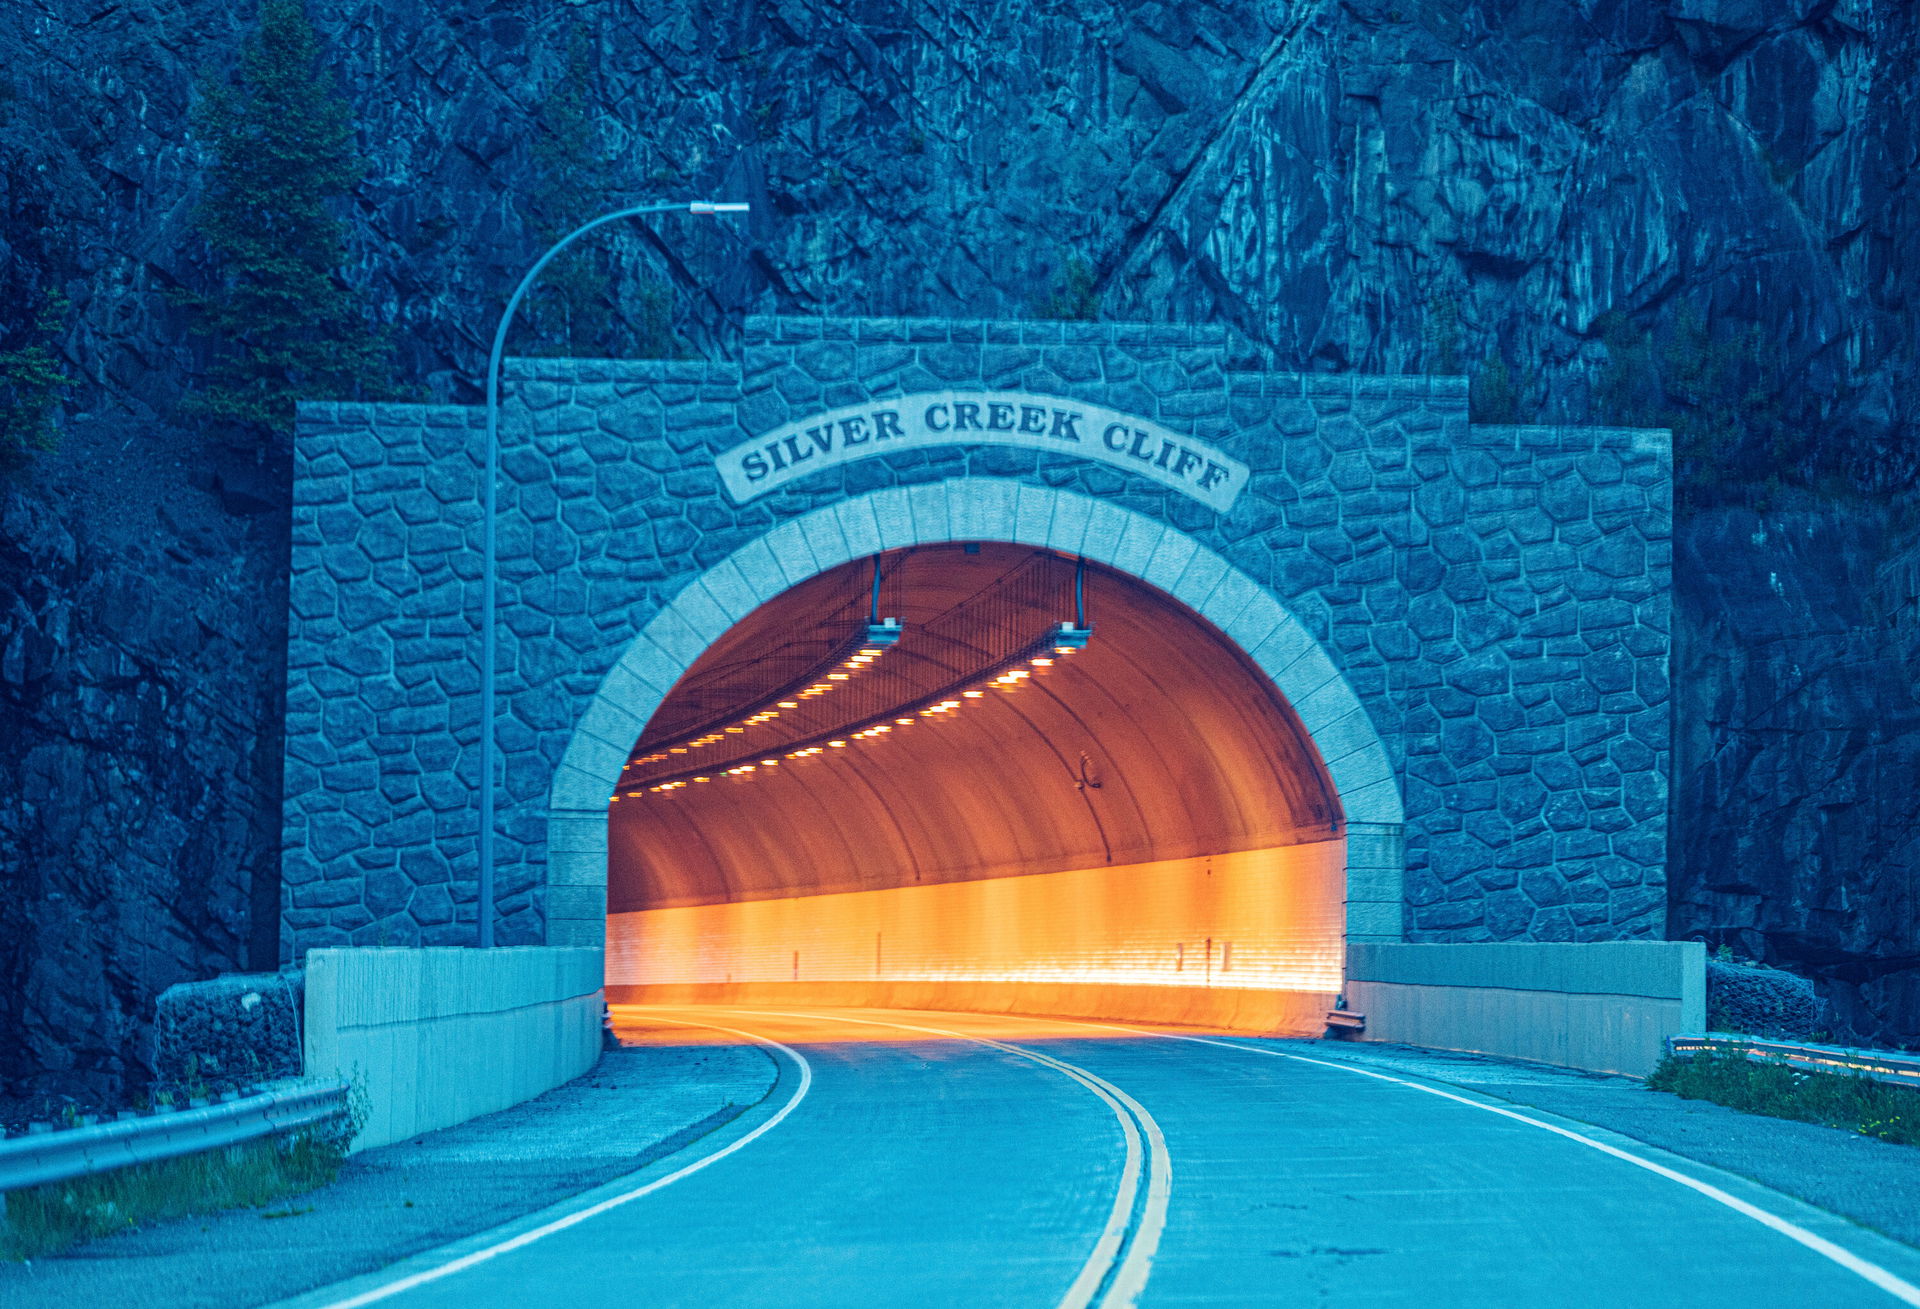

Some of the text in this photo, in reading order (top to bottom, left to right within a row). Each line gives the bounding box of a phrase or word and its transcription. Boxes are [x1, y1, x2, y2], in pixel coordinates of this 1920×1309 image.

[741, 402, 1230, 493] SILVER CREEK CLIFF
